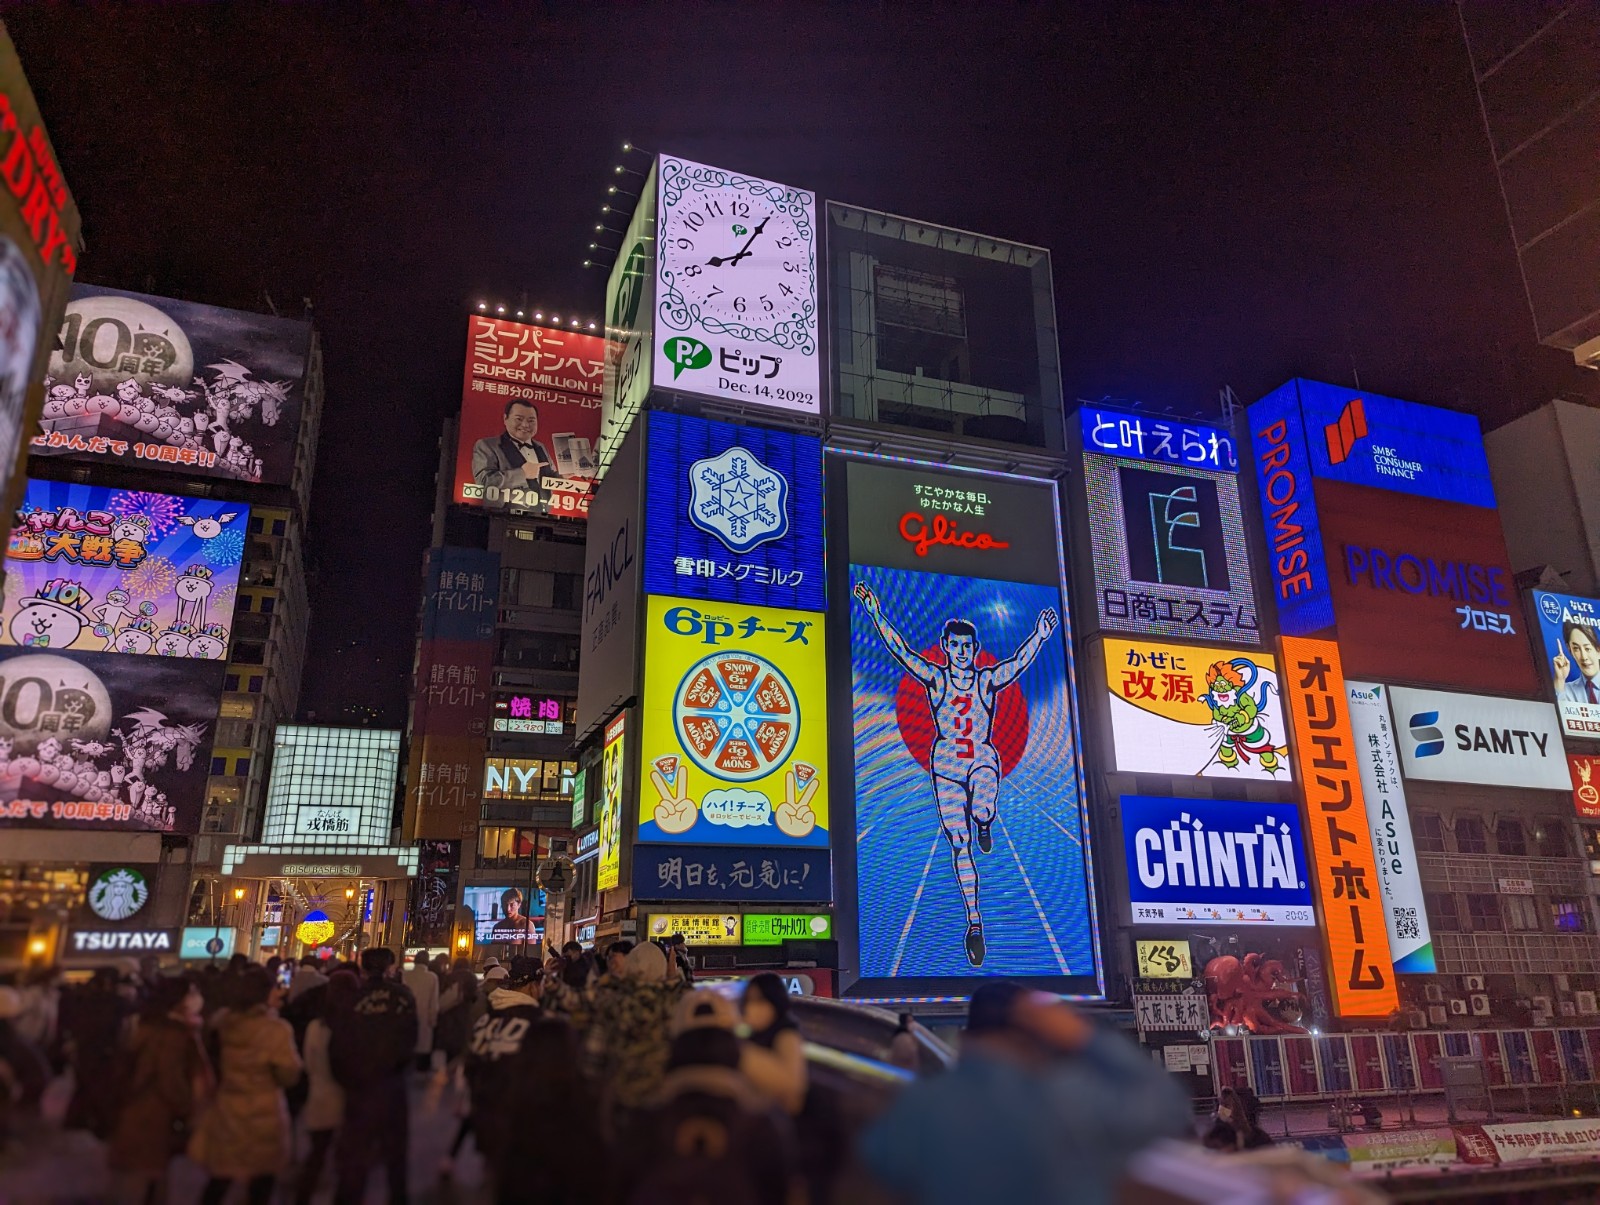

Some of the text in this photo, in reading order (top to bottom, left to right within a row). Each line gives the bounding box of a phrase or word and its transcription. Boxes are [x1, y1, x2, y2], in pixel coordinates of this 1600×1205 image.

[704, 201, 724, 218] 11
[729, 201, 750, 218] 12
[683, 212, 704, 232] 10
[676, 238, 694, 251] 9
[775, 236, 792, 250] 2
[684, 264, 702, 278] 8
[783, 262, 800, 274] 3
[707, 285, 724, 298] 7
[778, 282, 794, 297] 4
[733, 296, 747, 313] 6
[759, 294, 774, 312] 5
[475, 321, 565, 349] スーパー
[117, 354, 165, 378] 周年
[474, 341, 604, 379] ミリオンヘア
[719, 346, 783, 379] ピップ
[473, 363, 527, 380] SUPER
[531, 372, 588, 392] MILLION
[718, 377, 814, 406] Dec. 14, 2022
[1091, 413, 1237, 468] と叶えられ
[1372, 444, 1397, 458] SMBC
[1374, 455, 1423, 473] CONSUMER
[1376, 465, 1416, 480] FINANCE
[913, 484, 992, 505] すこやかな毎日、
[920, 497, 985, 516] ゆたかな人生
[1257, 419, 1313, 599] PROMISE
[899, 511, 1009, 557] Glico
[46, 534, 147, 567] 大戦争
[440, 571, 486, 592] 龍角散
[585, 518, 634, 624] FANCL
[673, 556, 804, 587] 雪印メグミルク
[1344, 544, 1511, 606] PROMISE
[1103, 588, 1260, 630] 日商エステム
[1456, 605, 1516, 635] プロミス
[725, 663, 754, 673] SNOW
[1126, 649, 1187, 671] かぜに
[430, 663, 480, 685] 龍角散
[688, 673, 708, 702] SNOW
[768, 681, 788, 708] SNOW
[1121, 670, 1197, 703] 改源
[1351, 689, 1374, 700] Asue
[510, 696, 559, 719] 焼肉
[39, 713, 83, 734] 周年
[950, 693, 975, 760] グリコ
[686, 722, 707, 751] SNOW
[769, 728, 788, 756] SNOW
[1454, 723, 1549, 758] SAMTY
[420, 762, 470, 784] 龍角散
[722, 760, 752, 769] SNOW
[317, 809, 342, 818] なんば
[1368, 733, 1402, 875] 株式会社 Asue
[306, 818, 349, 832] 戎橋筋
[1298, 656, 1385, 990] オリエントホーム
[1135, 811, 1299, 890] CHINTAI
[1375, 828, 1393, 900] に変わりました。
[1137, 908, 1164, 918] 天気予報
[771, 917, 808, 936] ピタットハウス
[74, 932, 170, 949] TSUTAYA
[1148, 945, 1181, 973] くくる
[1140, 1000, 1199, 1025] 大阪に乾杯
